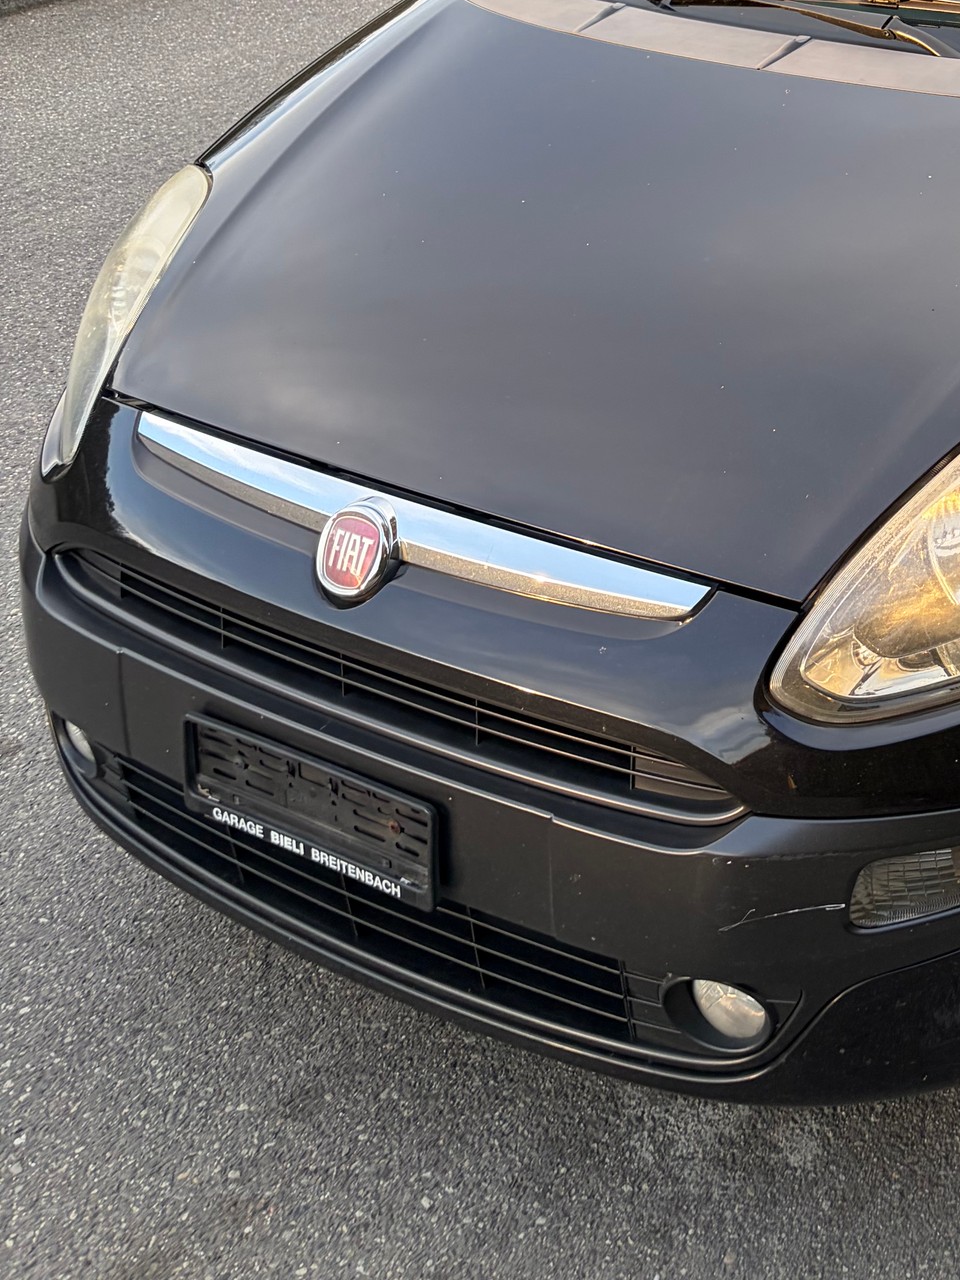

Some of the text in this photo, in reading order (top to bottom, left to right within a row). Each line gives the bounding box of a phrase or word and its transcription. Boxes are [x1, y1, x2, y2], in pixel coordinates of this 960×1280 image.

[328, 528, 375, 578] FIAT
[212, 807, 401, 898] GARAGE BIELI BREITENBACH
